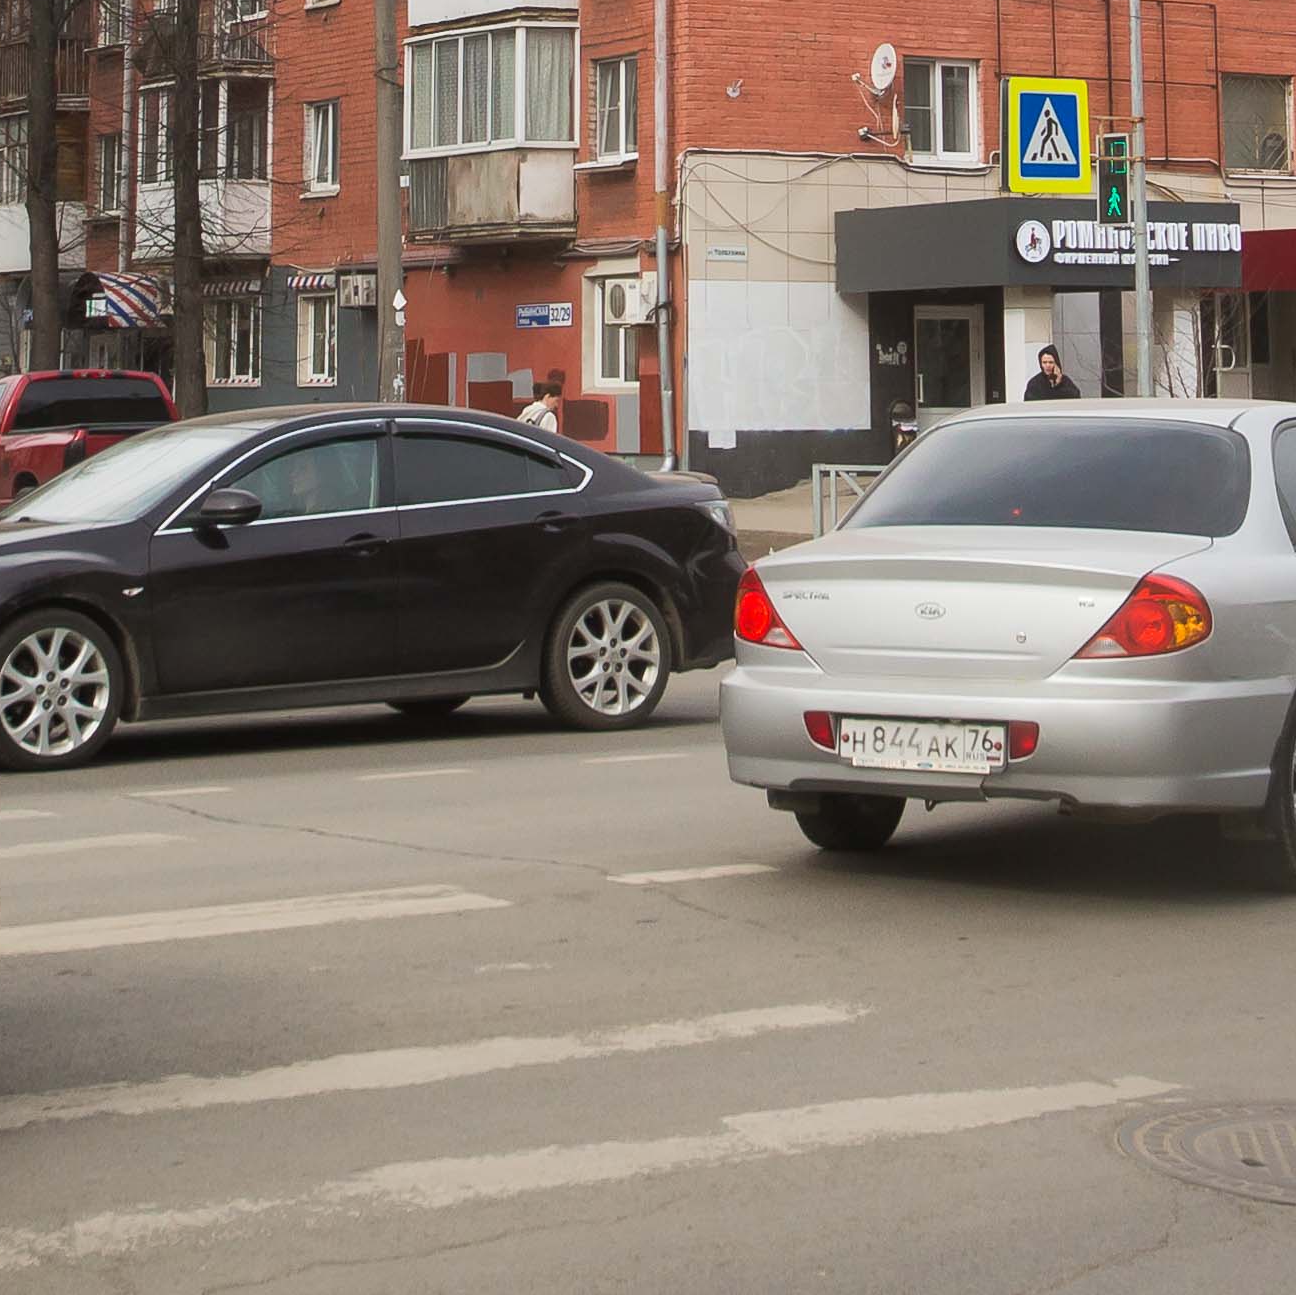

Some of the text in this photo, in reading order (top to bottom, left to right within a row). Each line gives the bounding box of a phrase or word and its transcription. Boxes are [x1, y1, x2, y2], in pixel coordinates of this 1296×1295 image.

[1052, 219, 1242, 252] РОМАНОСКОЕ ПИВО
[968, 728, 994, 753] 76
